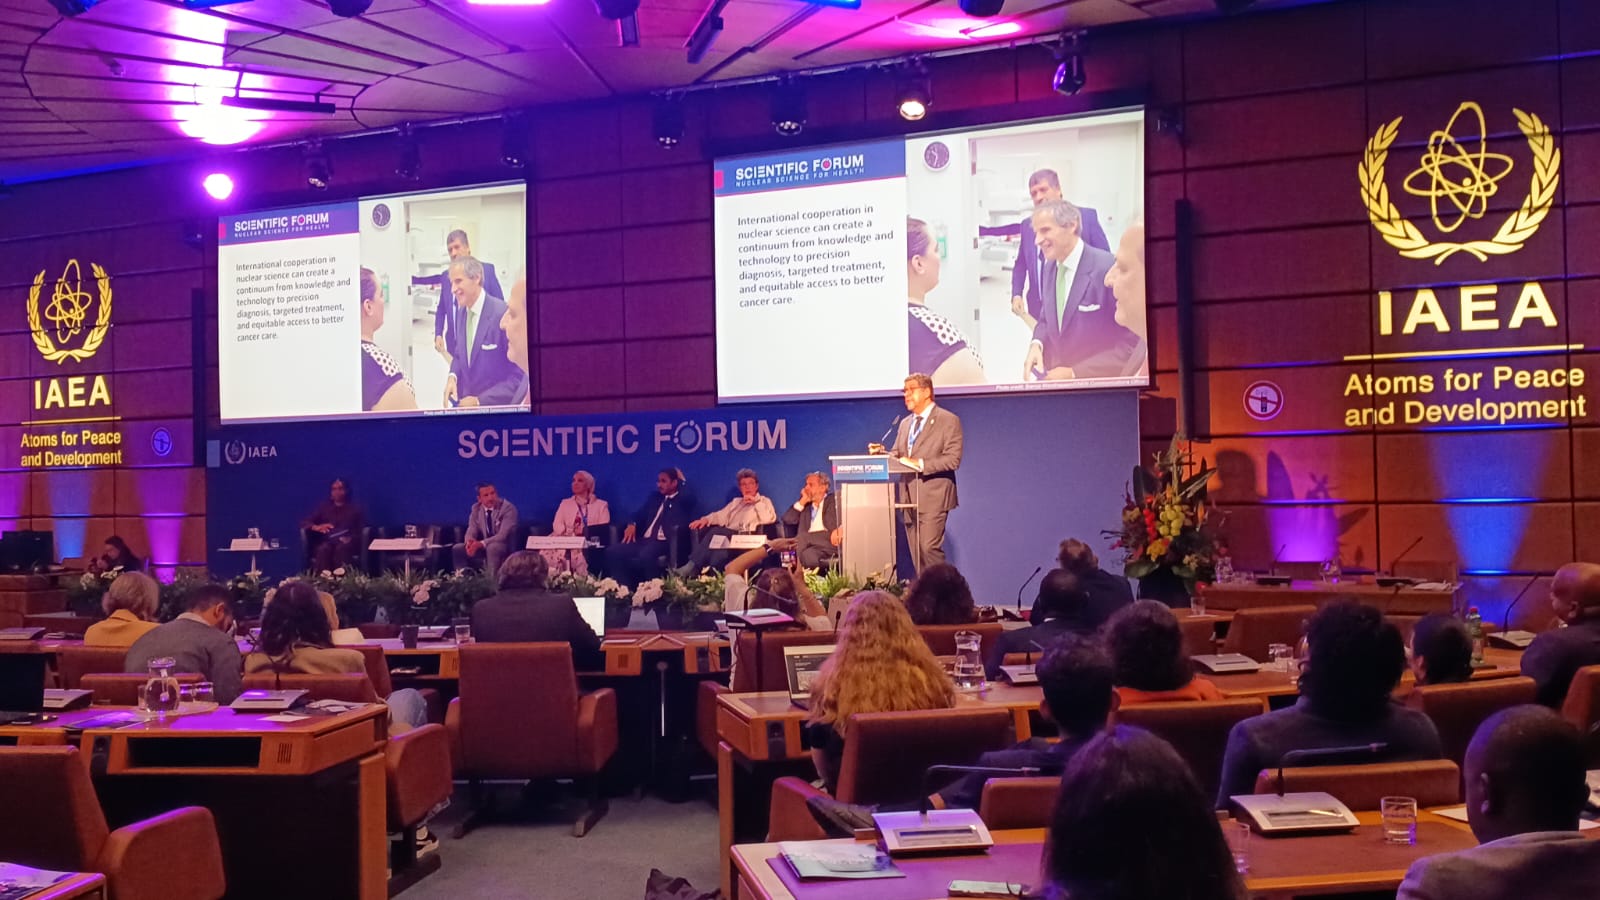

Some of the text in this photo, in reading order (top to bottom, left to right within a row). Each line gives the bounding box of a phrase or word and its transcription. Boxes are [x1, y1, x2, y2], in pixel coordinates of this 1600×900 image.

[736, 154, 864, 180] SCIENTIFIC FORUM
[736, 178, 771, 187] NUCLEAR
[776, 174, 809, 182] SCIENCE
[833, 168, 864, 176] HEALTH
[235, 213, 328, 231] SCIENTIFIC FORUM
[738, 205, 873, 226] International cooperation in
[738, 228, 773, 239] nuclear
[776, 225, 810, 236] science
[813, 224, 829, 232] can
[833, 220, 863, 230] create
[738, 230, 893, 253] continuum from knowledge and
[236, 260, 281, 271] International
[284, 256, 326, 268] cooperation
[739, 250, 850, 267] technology to precision
[236, 274, 261, 283] nuclear
[264, 272, 289, 280] science
[306, 269, 328, 277] create
[739, 261, 885, 281] diagnosis, targeted treatment,
[237, 286, 274, 295] continuum
[295, 280, 334, 290] knowledge
[337, 278, 350, 286] and
[739, 283, 756, 294] and
[759, 281, 804, 292] equitable
[807, 280, 837, 288] access
[854, 275, 884, 285] better
[237, 297, 275, 306] technology
[287, 294, 319, 303] precision
[740, 298, 769, 308] cancer
[1379, 281, 1557, 336] IAEA
[273, 306, 303, 316] targeted
[305, 304, 344, 313] treatment,
[252, 319, 285, 329] equitable
[321, 315, 344, 323] better
[238, 333, 259, 342] cancer
[1344, 366, 1584, 396] Atoms for Peace
[35, 375, 110, 409] IAEA
[1345, 394, 1586, 427] and Development
[21, 430, 121, 448] Atoms for Peace
[457, 419, 786, 458] SCIENTIFIC FORUM
[21, 450, 122, 468] and Development
[249, 446, 277, 457] IAEA
